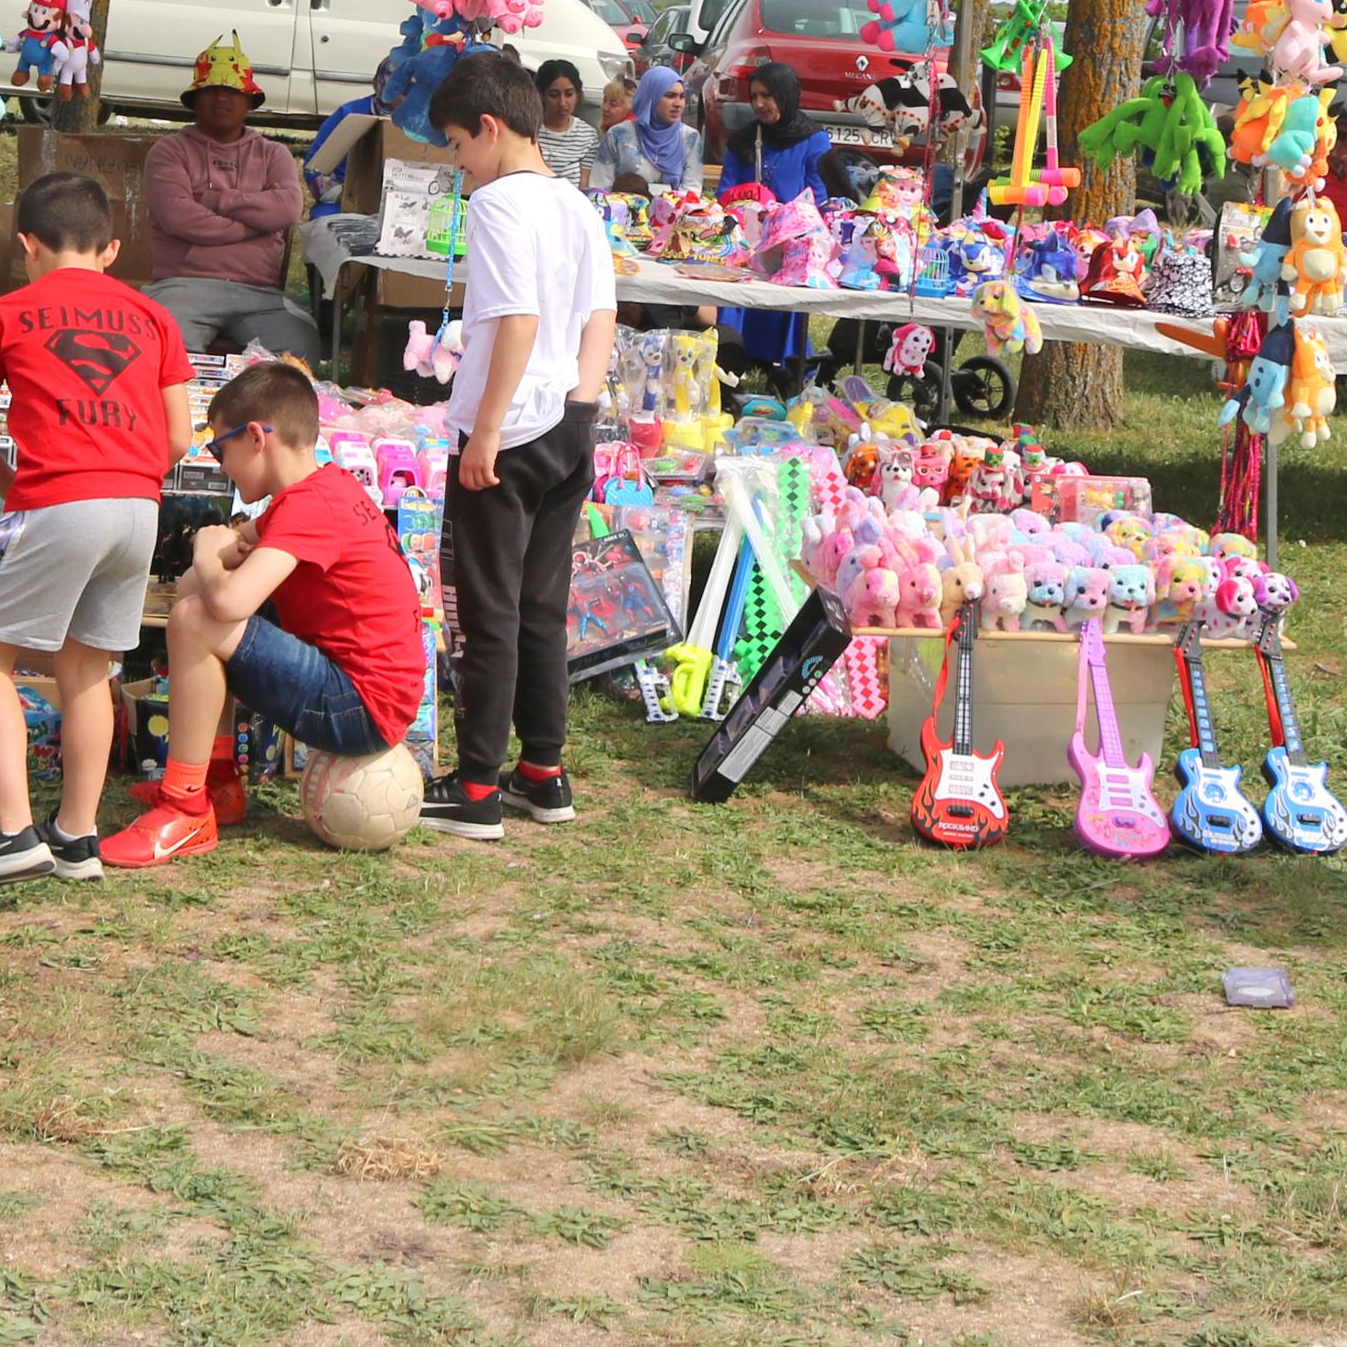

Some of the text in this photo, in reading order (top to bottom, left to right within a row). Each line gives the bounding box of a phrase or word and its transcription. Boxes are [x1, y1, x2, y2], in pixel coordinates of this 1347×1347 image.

[19, 306, 157, 341] SEIMUSS
[56, 398, 137, 432] FURY
[353, 501, 377, 527] SE
